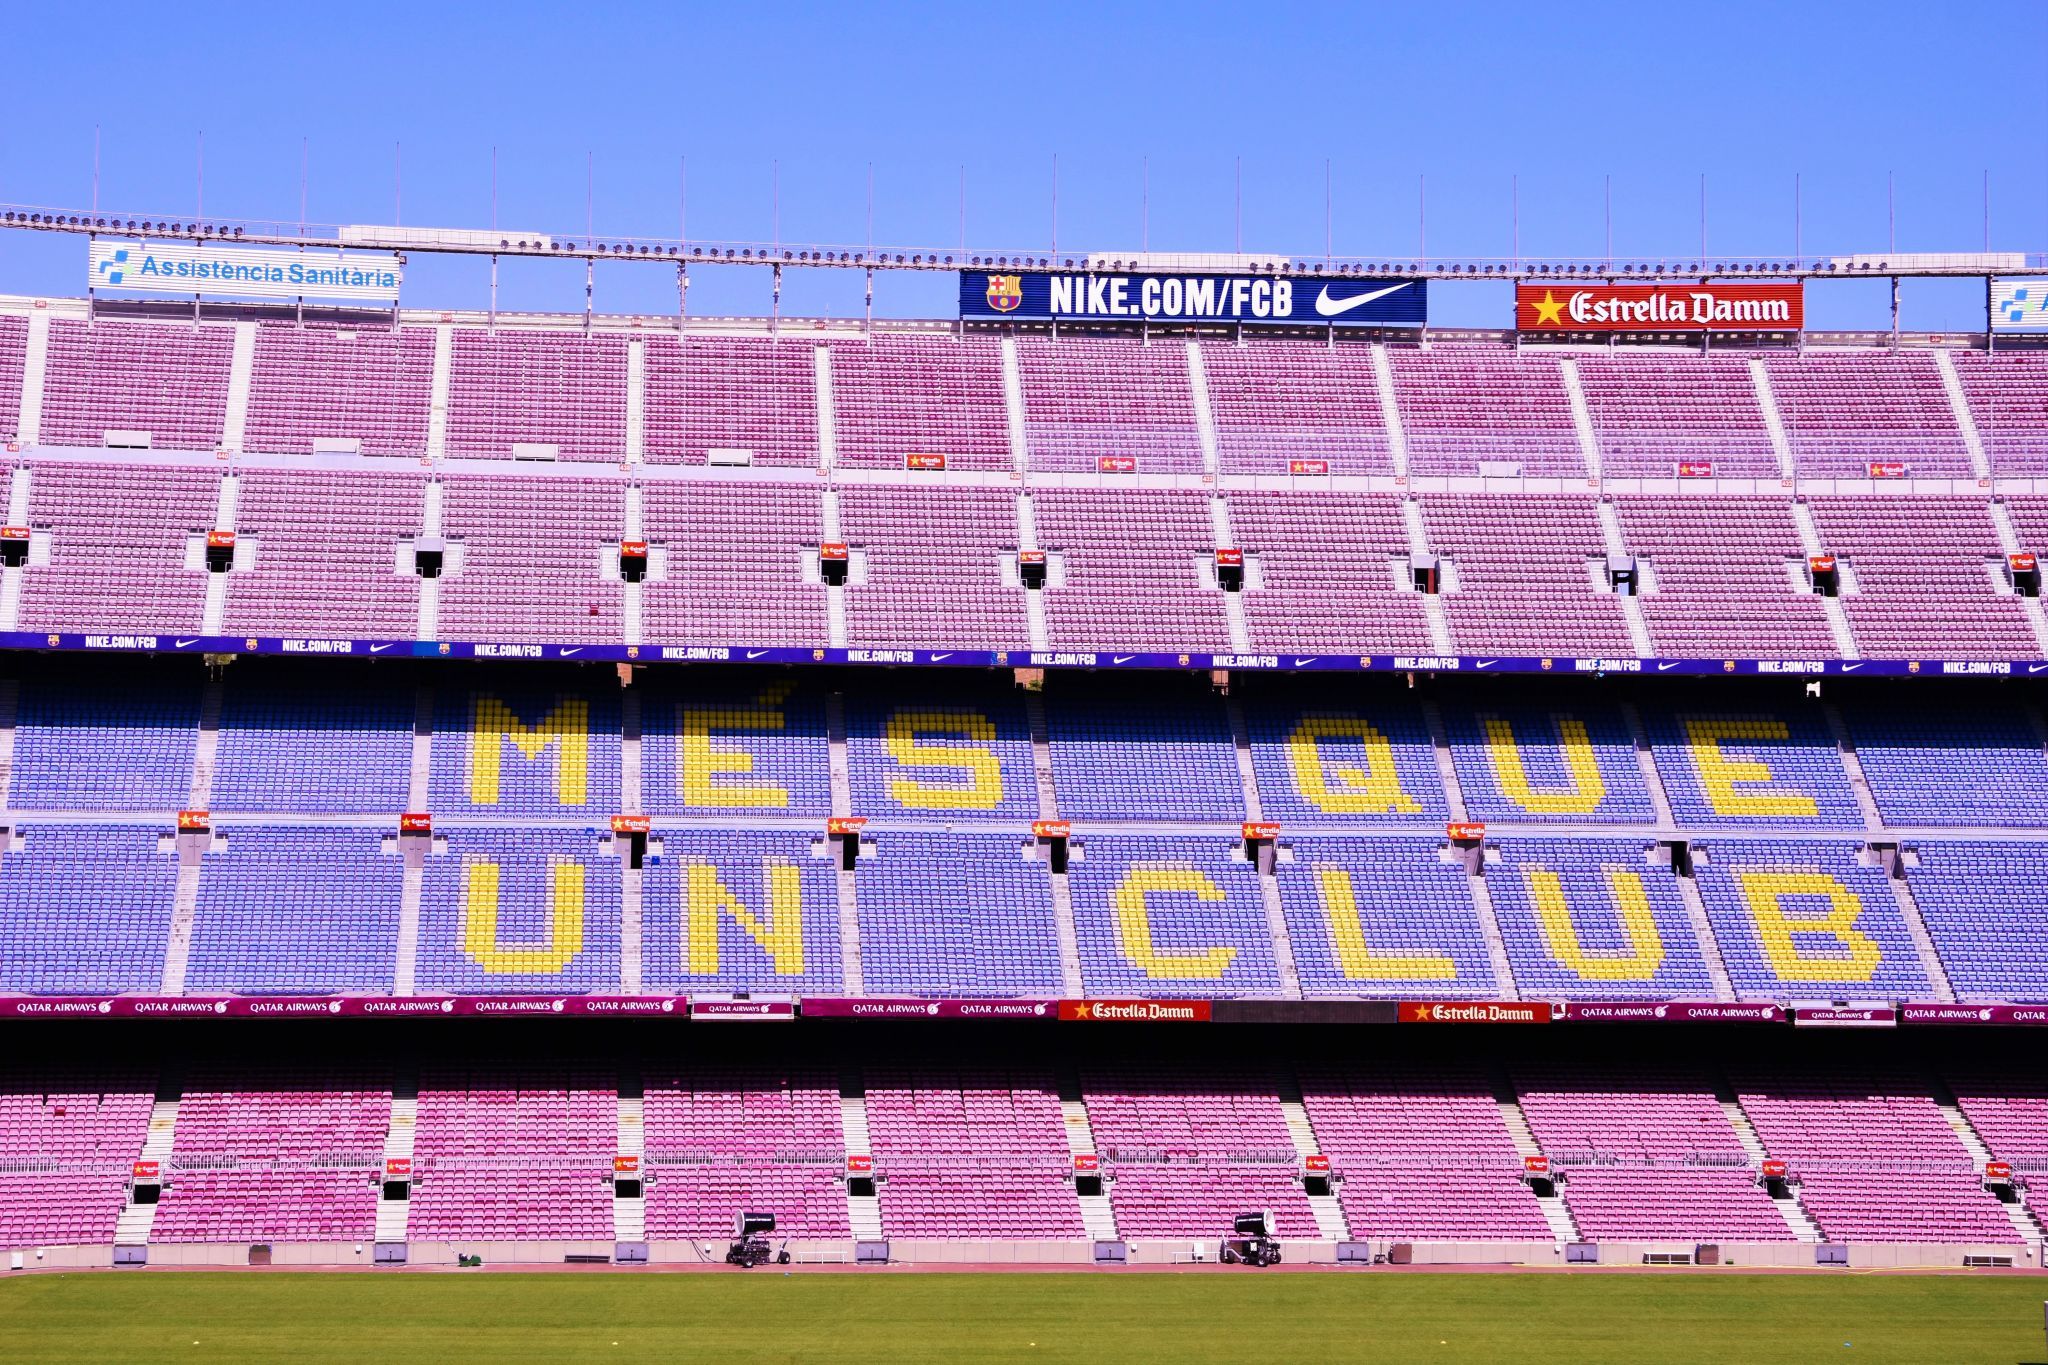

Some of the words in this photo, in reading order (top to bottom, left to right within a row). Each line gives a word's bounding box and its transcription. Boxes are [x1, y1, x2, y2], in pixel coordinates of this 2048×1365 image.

[141, 256, 283, 282] Assistència
[288, 263, 396, 287] Sanitària
[1050, 275, 1293, 318] NIKE.COM/FCB
[1568, 290, 1687, 324] Estrella
[1690, 292, 1789, 324] Damm
[85, 636, 157, 649] NIKE.COM/FCB
[282, 640, 352, 653] NIKE.COM/FCB
[474, 644, 542, 657] NIKE.COM/FCB
[663, 647, 729, 660] NIKE.COM/FCB
[848, 650, 913, 662] NIKE.COM/FCB
[1030, 653, 1096, 666] NIKE.COM/FCB
[1213, 655, 1278, 668] NIKE.COM/FCB
[1394, 657, 1459, 670] NIKE.COM/FCB
[1575, 659, 1641, 671] NIKE.COM/FCB
[1758, 661, 1824, 673] NIKE.COM/FCB
[1943, 662, 2010, 674] NIKE.COM/FCB
[1290, 712, 1818, 816] QUE
[464, 863, 805, 975] UN
[1115, 868, 1882, 982] CLUB
[17, 1003, 51, 1013] QATAR
[54, 1003, 97, 1012] AIRWAYS
[135, 1003, 169, 1013] QATAR
[171, 1003, 213, 1012] AIRWAYS
[250, 1003, 284, 1013] QATAR
[286, 1003, 327, 1012] AIRWAYS
[364, 1003, 398, 1012] QATAR
[399, 1003, 440, 1011] AIRWAYS
[475, 1002, 508, 1011] QATAR
[509, 1002, 550, 1010] AIRWAYS
[587, 1002, 619, 1011] QATAR
[621, 1002, 660, 1010] AIRWAYS
[709, 1005, 731, 1013] QATAR
[853, 1004, 885, 1013] QATAR
[886, 1004, 925, 1013] AIRWAYS
[960, 1005, 992, 1014] QATAR
[994, 1005, 1033, 1013] AIRWAYS
[1092, 1002, 1147, 1019] Estrella
[1148, 1003, 1194, 1020] Damm
[1432, 1004, 1487, 1020] Estrella
[1488, 1005, 1533, 1021] Damm
[1581, 1008, 1613, 1017] QATAR
[1614, 1008, 1653, 1016] AIRWAYS
[1688, 1008, 1720, 1017] QATAR
[1721, 1008, 1760, 1017] AIRWAYS
[1904, 1010, 1936, 1019] QATAR
[1938, 1010, 1978, 1018] AIRWAYS
[2013, 1011, 2046, 1020] QATAR
